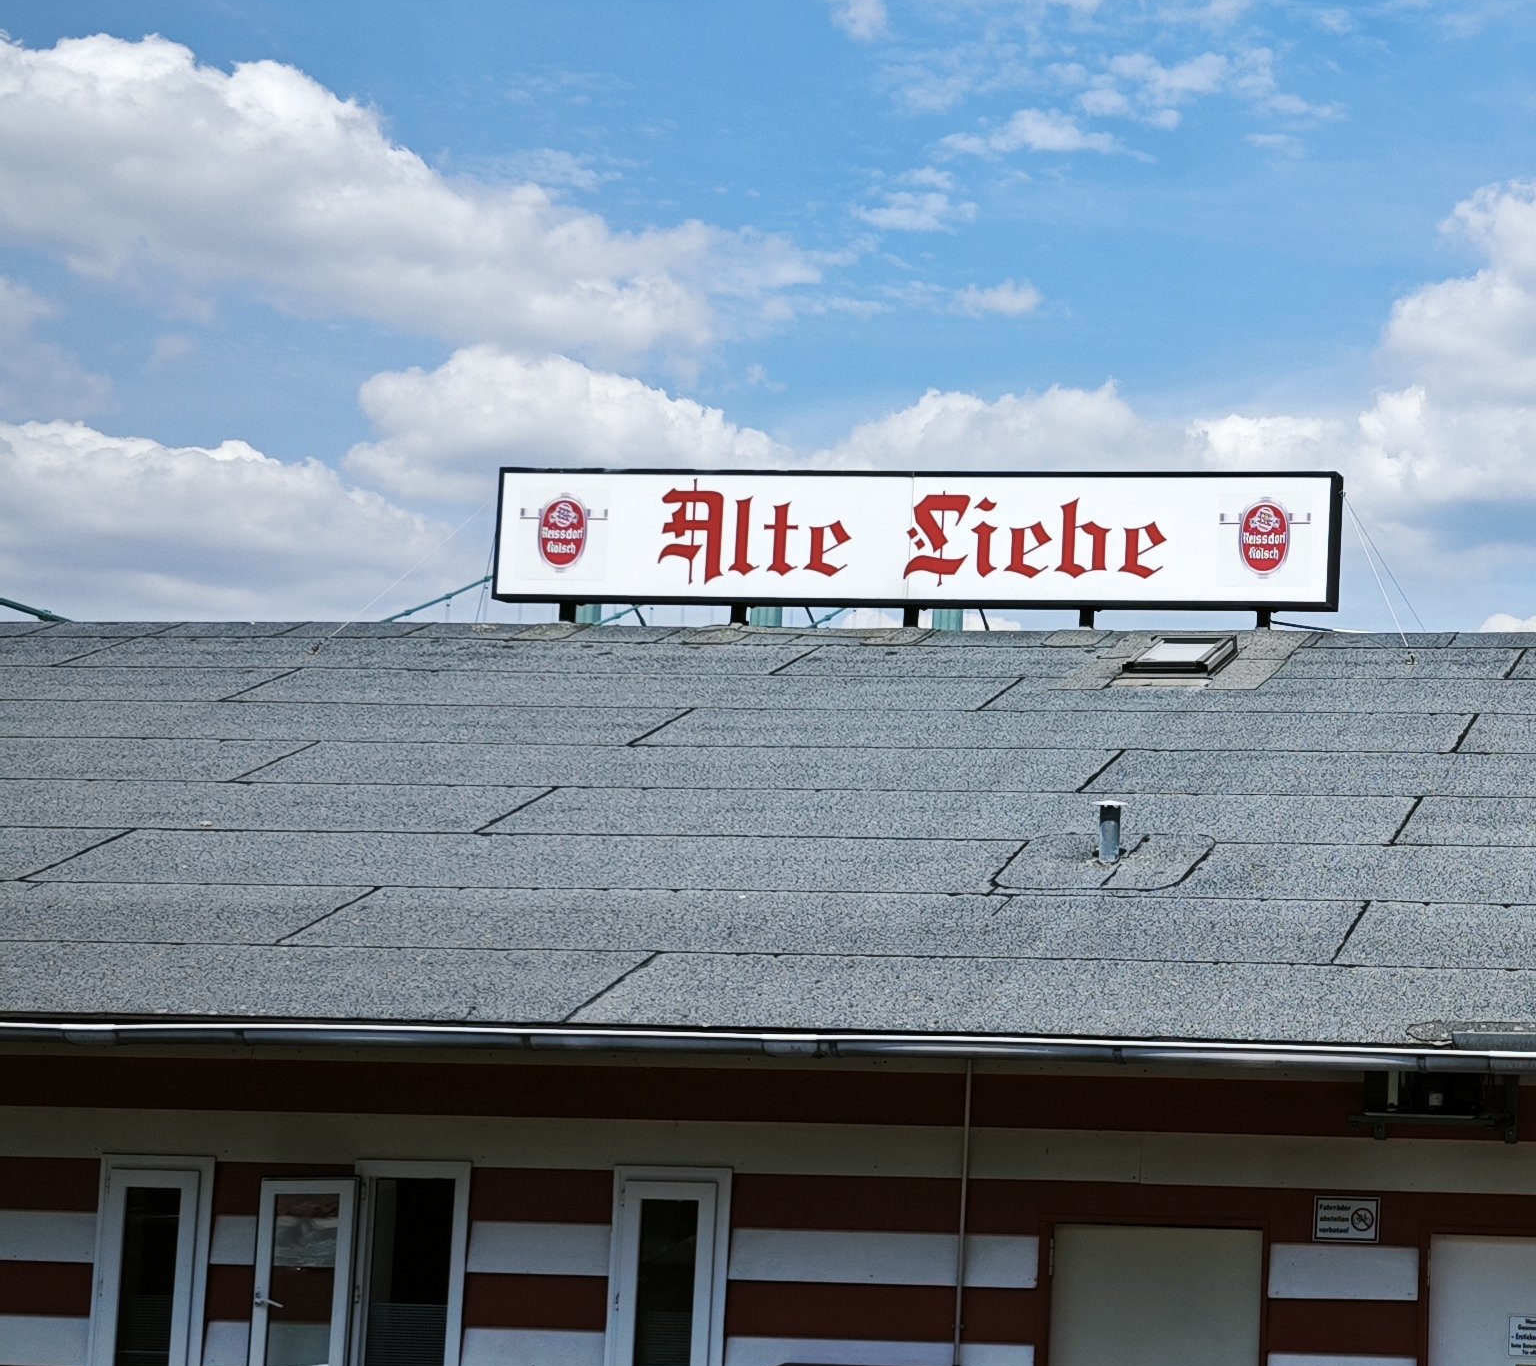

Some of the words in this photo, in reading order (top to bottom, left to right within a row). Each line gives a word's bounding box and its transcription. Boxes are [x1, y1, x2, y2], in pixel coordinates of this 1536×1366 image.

[541, 527, 584, 540] Reissdorf
[658, 479, 852, 585] Alte
[903, 491, 1168, 587] Liebe
[1243, 532, 1286, 545] Reissdorf
[1248, 546, 1279, 560] Kölsch
